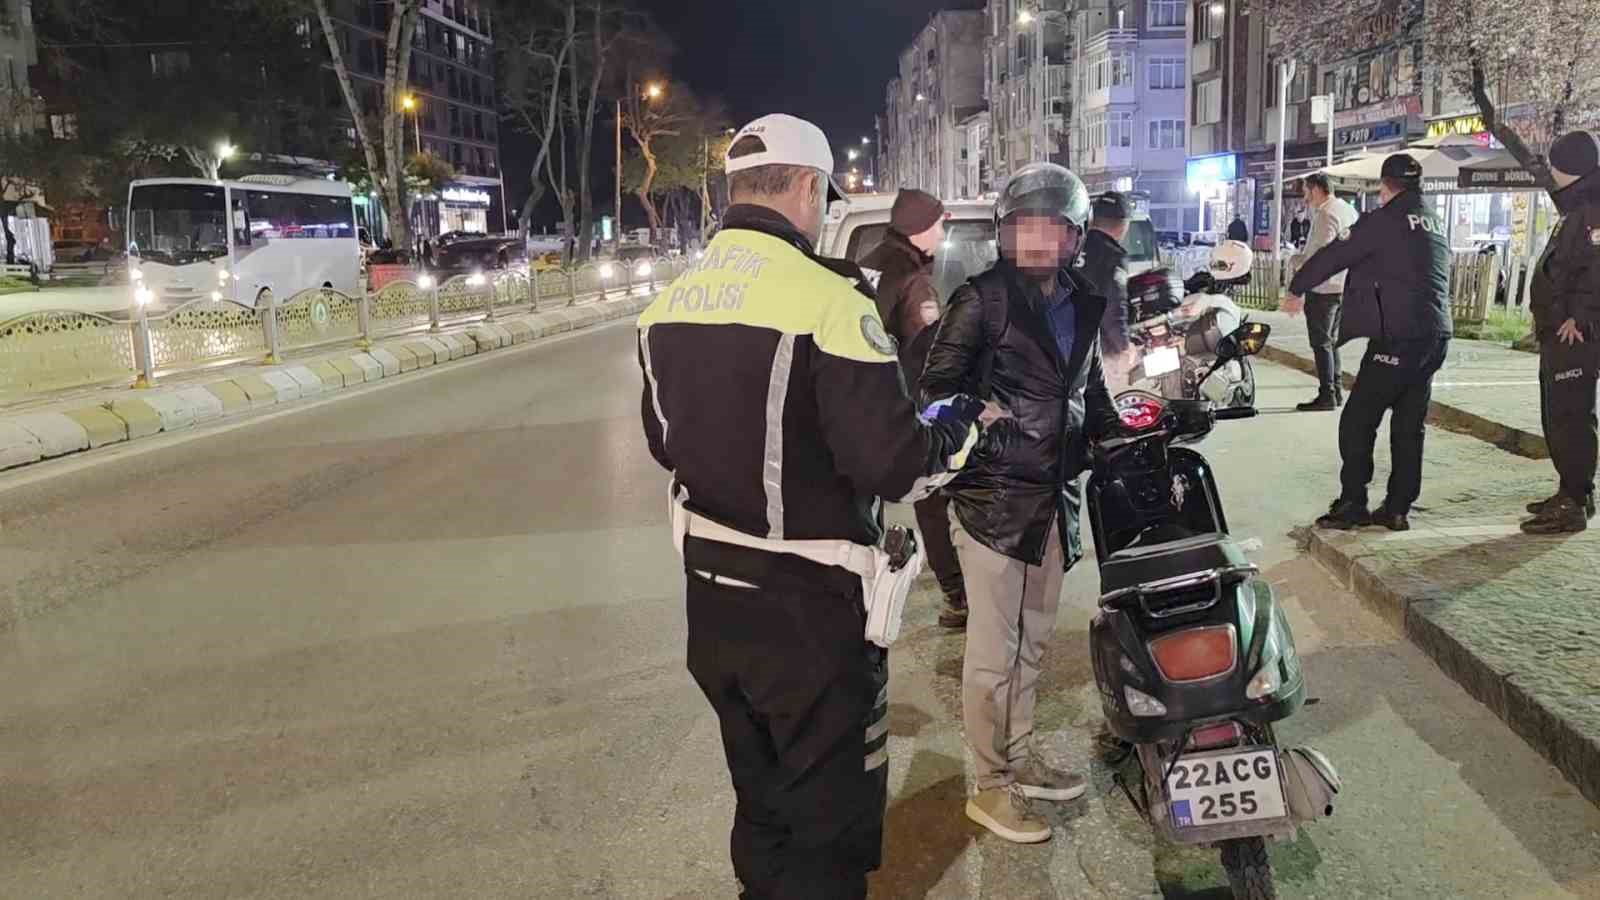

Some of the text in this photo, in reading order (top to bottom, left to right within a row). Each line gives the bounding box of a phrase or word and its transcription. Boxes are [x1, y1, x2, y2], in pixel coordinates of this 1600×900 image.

[1171, 755, 1272, 790] 22ACG
[1199, 790, 1258, 820] 255
[1177, 816, 1192, 826] TR
